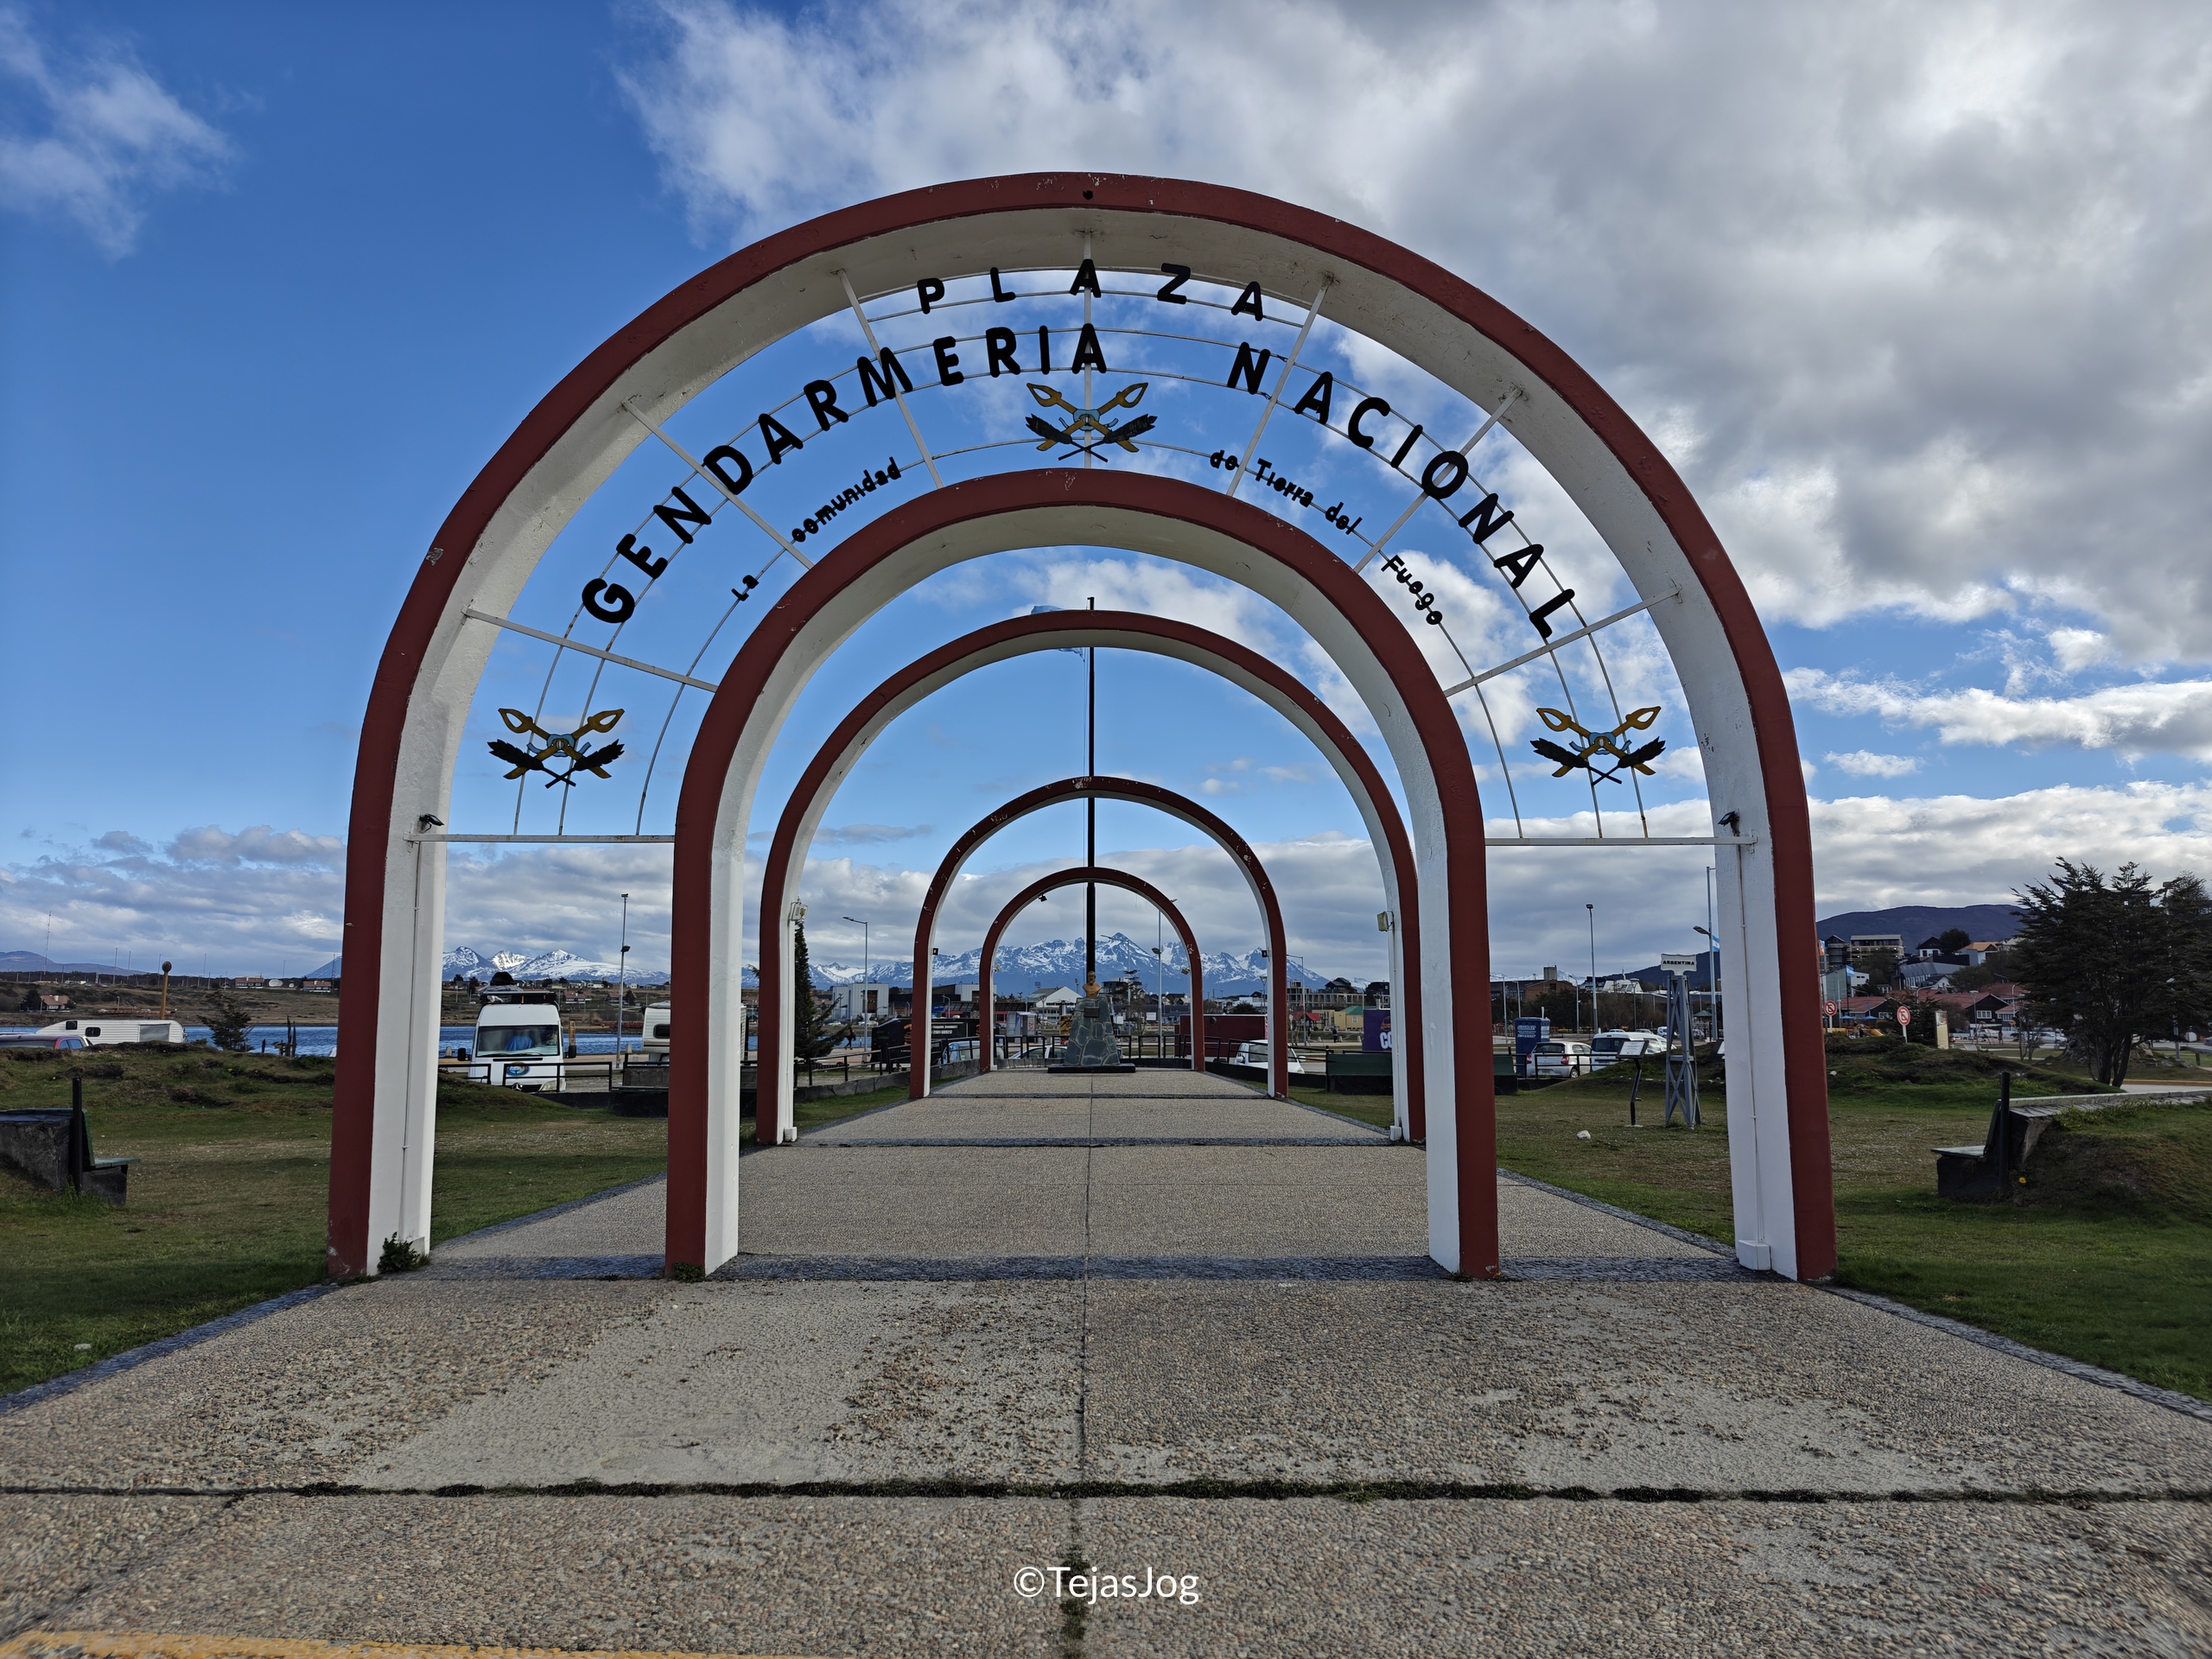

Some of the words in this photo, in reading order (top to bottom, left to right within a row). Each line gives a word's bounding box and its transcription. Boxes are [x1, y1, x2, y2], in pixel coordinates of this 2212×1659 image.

[917, 258, 1263, 321] PLAZA
[582, 323, 1107, 624] GENDARMERIA
[1227, 341, 1575, 639] NACIONAL
[731, 574, 760, 601] La
[791, 456, 902, 543] comunidad
[1210, 449, 1239, 471] de
[1255, 458, 1313, 508] Tierra
[1325, 501, 1363, 535] del
[1381, 555, 1443, 625] Fuego
